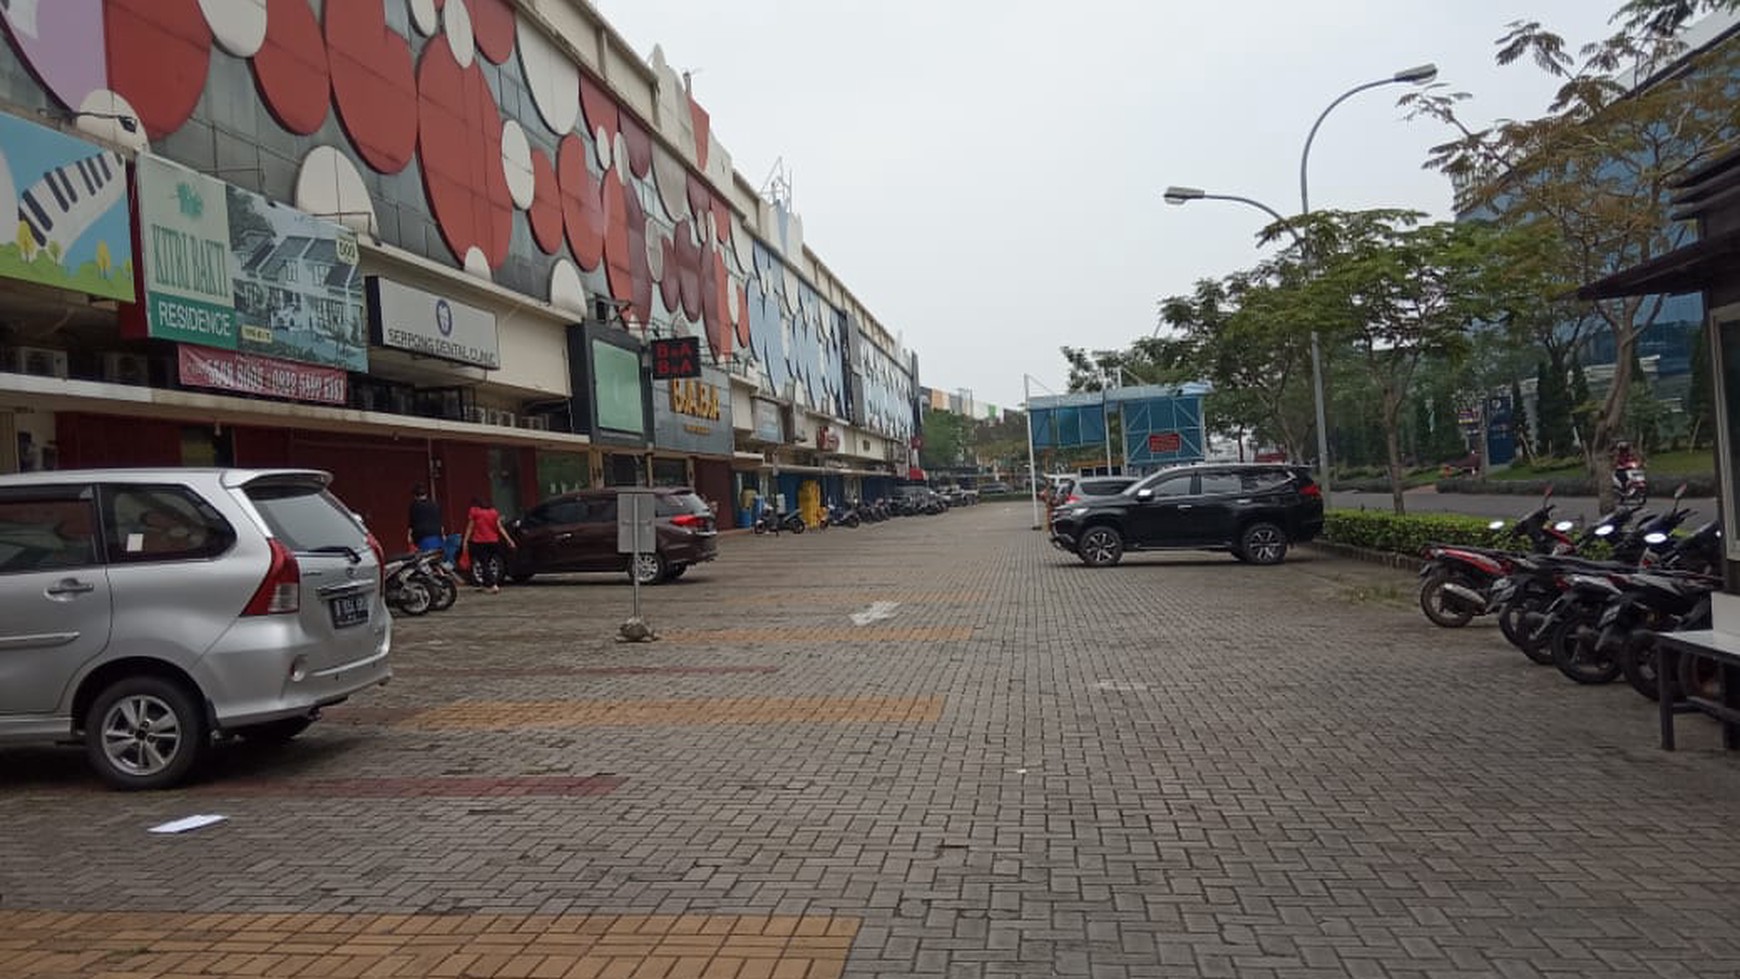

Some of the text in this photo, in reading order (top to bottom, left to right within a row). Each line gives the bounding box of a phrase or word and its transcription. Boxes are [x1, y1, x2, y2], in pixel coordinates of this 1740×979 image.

[190, 235, 229, 298] BAKTI
[157, 300, 232, 336] RESIDENCE
[387, 328, 496, 366] SERPONG DENTAL CLINIC
[670, 378, 721, 421] BABA
